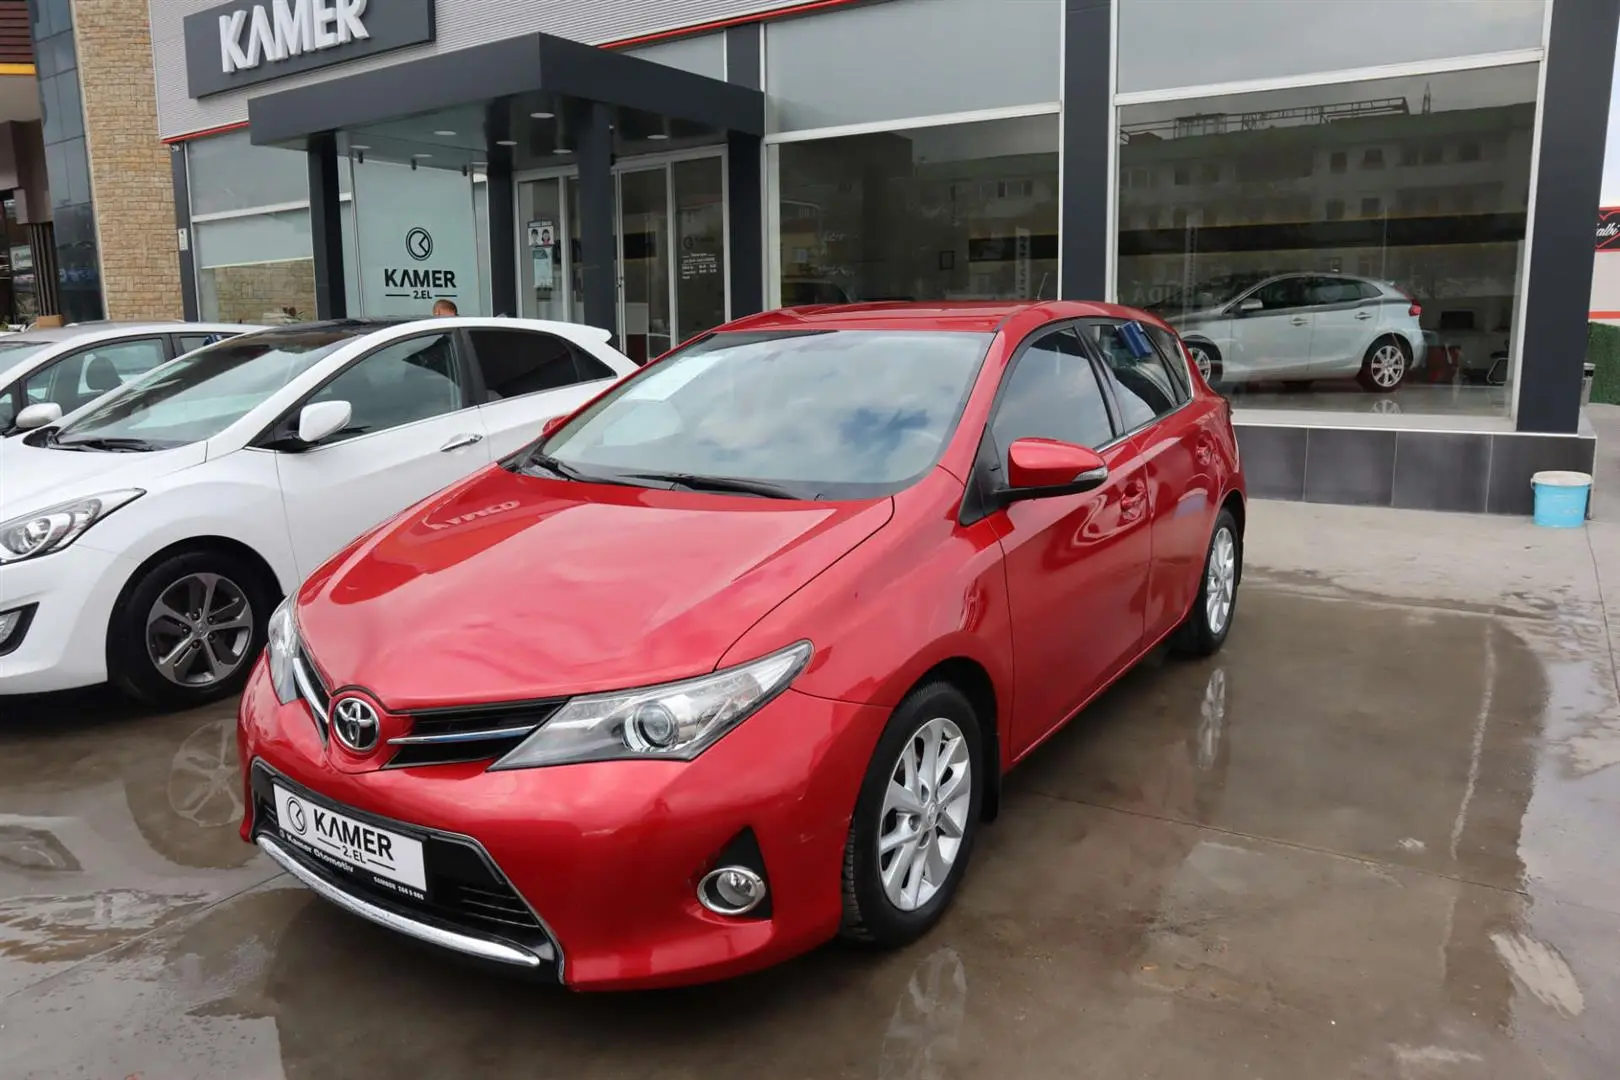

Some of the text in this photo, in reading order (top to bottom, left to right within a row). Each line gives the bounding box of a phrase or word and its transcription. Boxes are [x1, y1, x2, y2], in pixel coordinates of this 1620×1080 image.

[219, 0, 370, 73] KAMER
[384, 268, 457, 288] KAMER
[413, 290, 432, 299] 2.EL
[314, 808, 394, 861] KAMER
